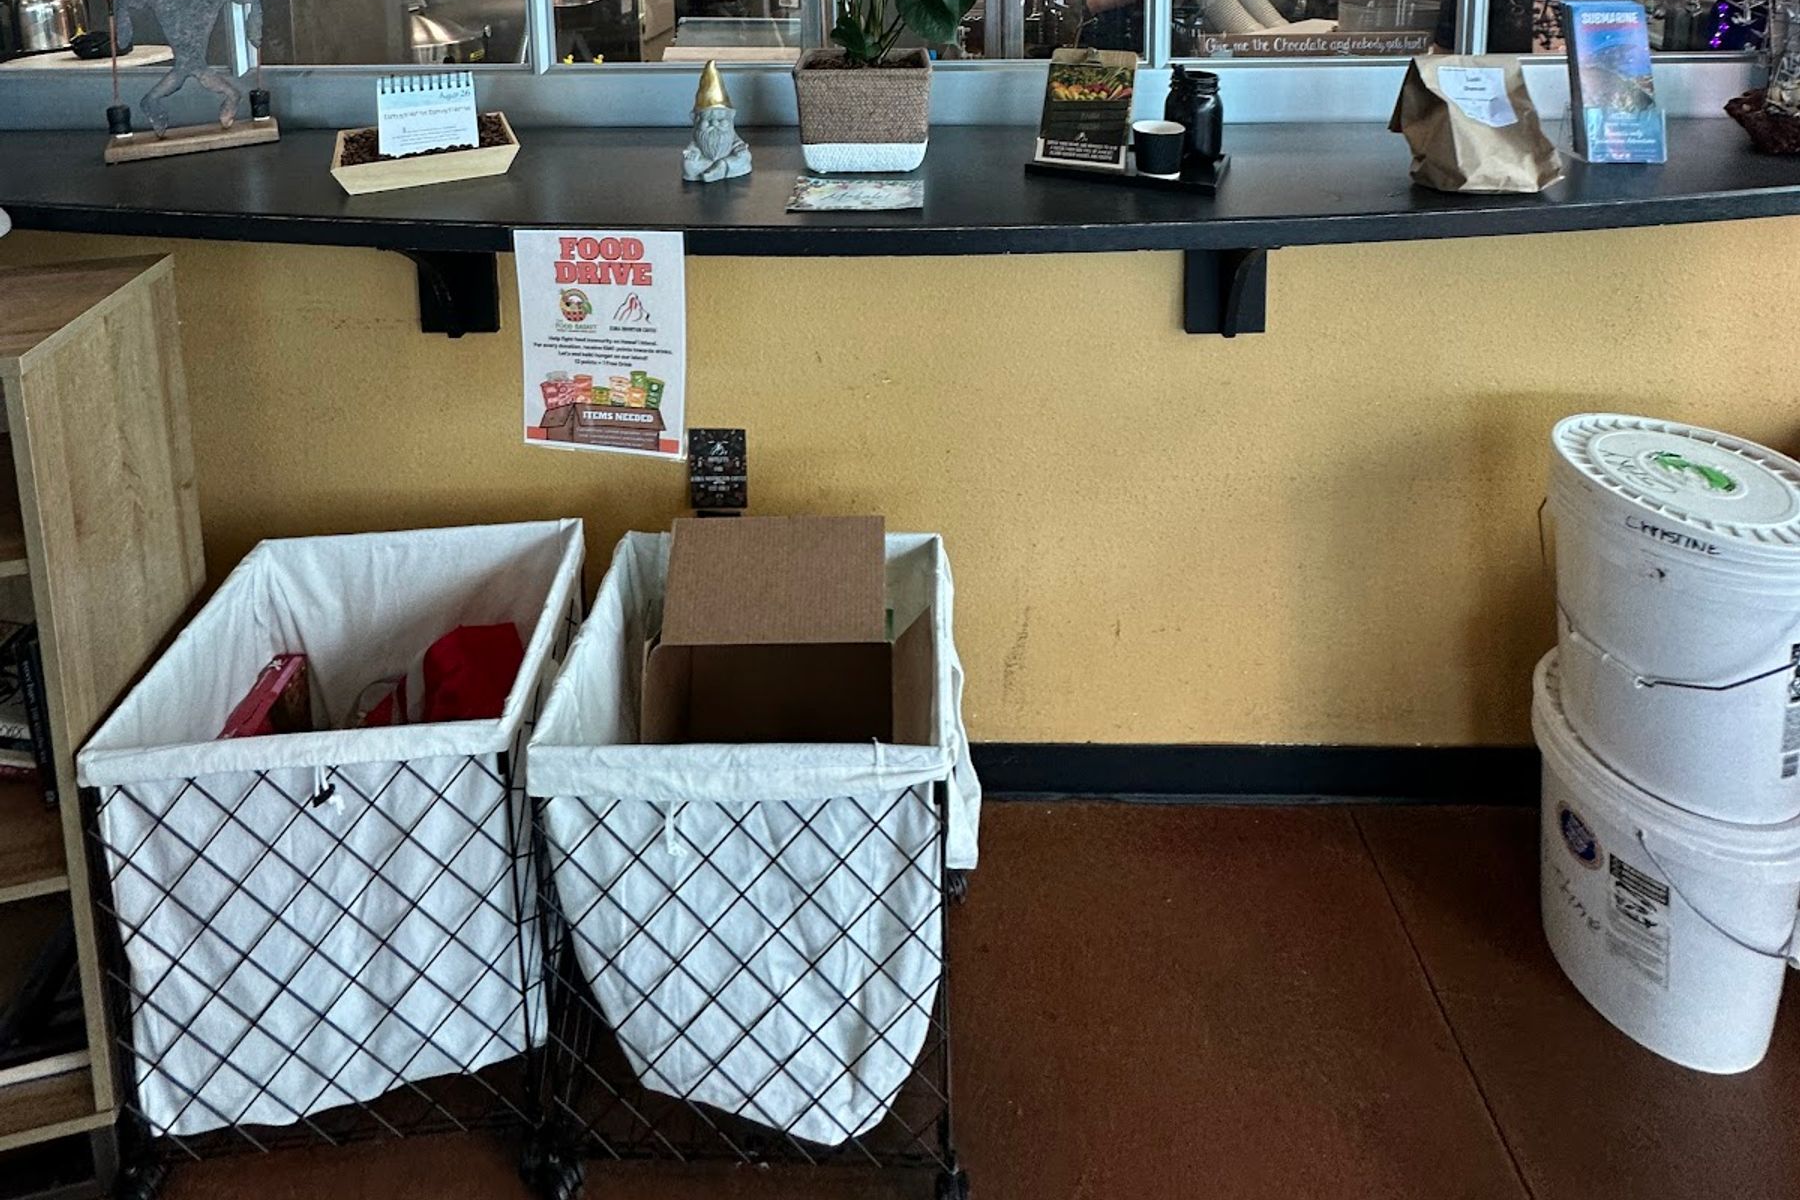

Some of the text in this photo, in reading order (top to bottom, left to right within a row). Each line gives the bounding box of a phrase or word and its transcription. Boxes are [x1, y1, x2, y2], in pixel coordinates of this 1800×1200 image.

[1581, 11, 1639, 25] SUBMARINE
[1233, 41, 1249, 52] me
[1252, 38, 1270, 52] the
[1273, 37, 1328, 52] Chocolate
[1329, 37, 1351, 54] and
[1351, 37, 1385, 53] nobody
[558, 237, 645, 261] FOOD
[554, 261, 653, 286] DRIVE
[582, 410, 654, 423] ITEMS NEEDED
